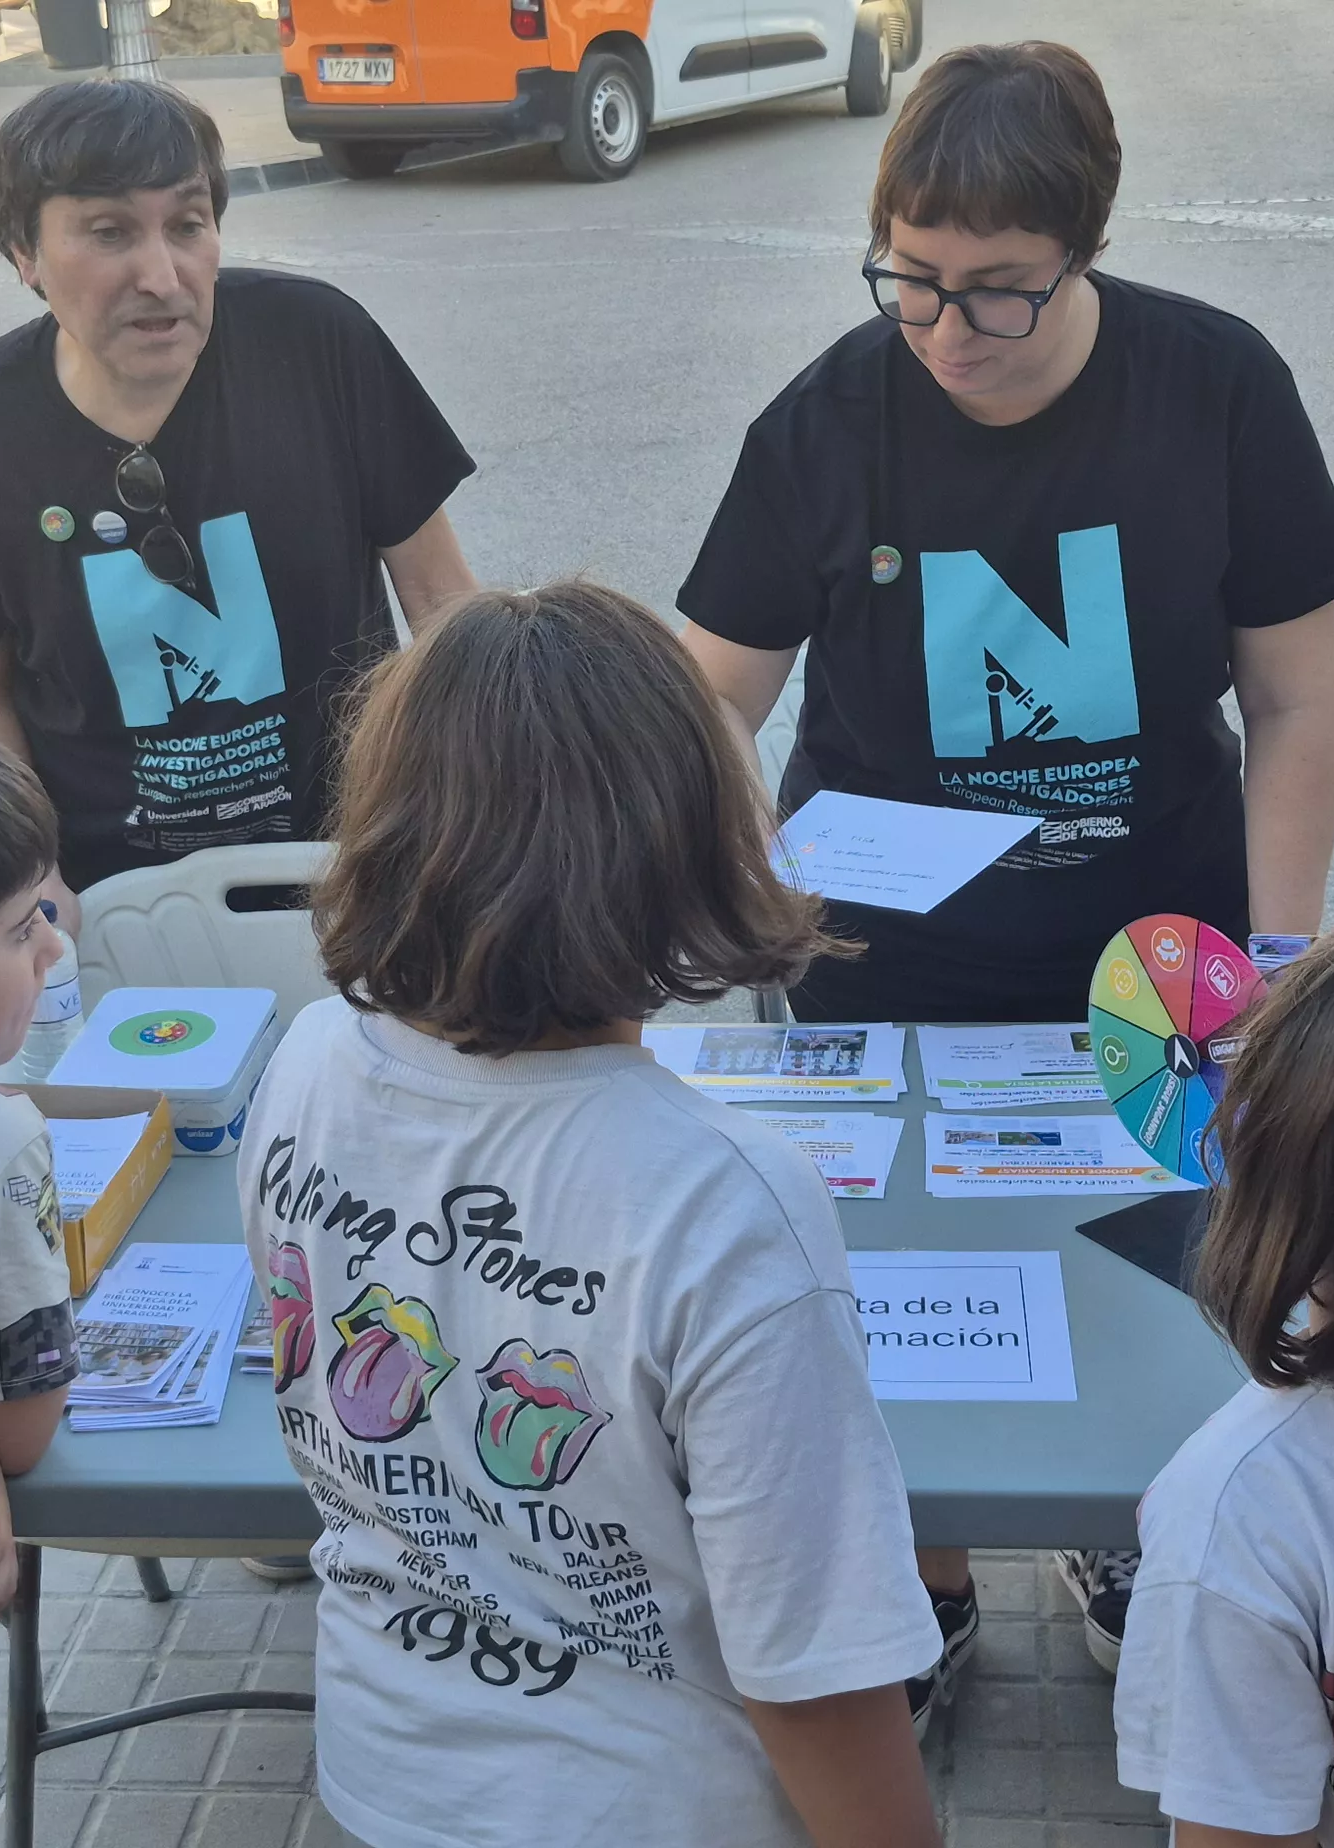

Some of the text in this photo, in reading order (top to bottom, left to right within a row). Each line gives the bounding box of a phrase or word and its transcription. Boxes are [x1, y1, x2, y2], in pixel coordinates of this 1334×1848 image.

[329, 60, 391, 79] 1727 MXV
[134, 712, 287, 753] LA NOCHE EUROPEA
[141, 732, 282, 772] INVESTIGADORES
[144, 747, 287, 790] INVESTIGADORAS
[259, 763, 291, 783] Night
[939, 771, 964, 786] LA
[968, 768, 1040, 786] NOCHE
[1045, 755, 1141, 783] EUROPEA
[147, 806, 210, 821] Universidad
[1062, 816, 1123, 832] GOBIERNO
[1062, 825, 1130, 842] DE ARAGON
[406, 1184, 606, 1315] Stones
[102, 1301, 175, 1312] UNIVERSIDAD
[903, 1297, 952, 1315] de
[965, 1296, 1000, 1315] la
[866, 1327, 1020, 1347] mación
[375, 1501, 451, 1525] BOSTON
[518, 1501, 632, 1550] TOUR
[397, 1549, 436, 1579] NEW
[508, 1552, 549, 1576] NEW
[563, 1551, 643, 1569] DALLAS
[589, 1579, 653, 1609] MIAMI
[383, 1603, 578, 1697] 1989
